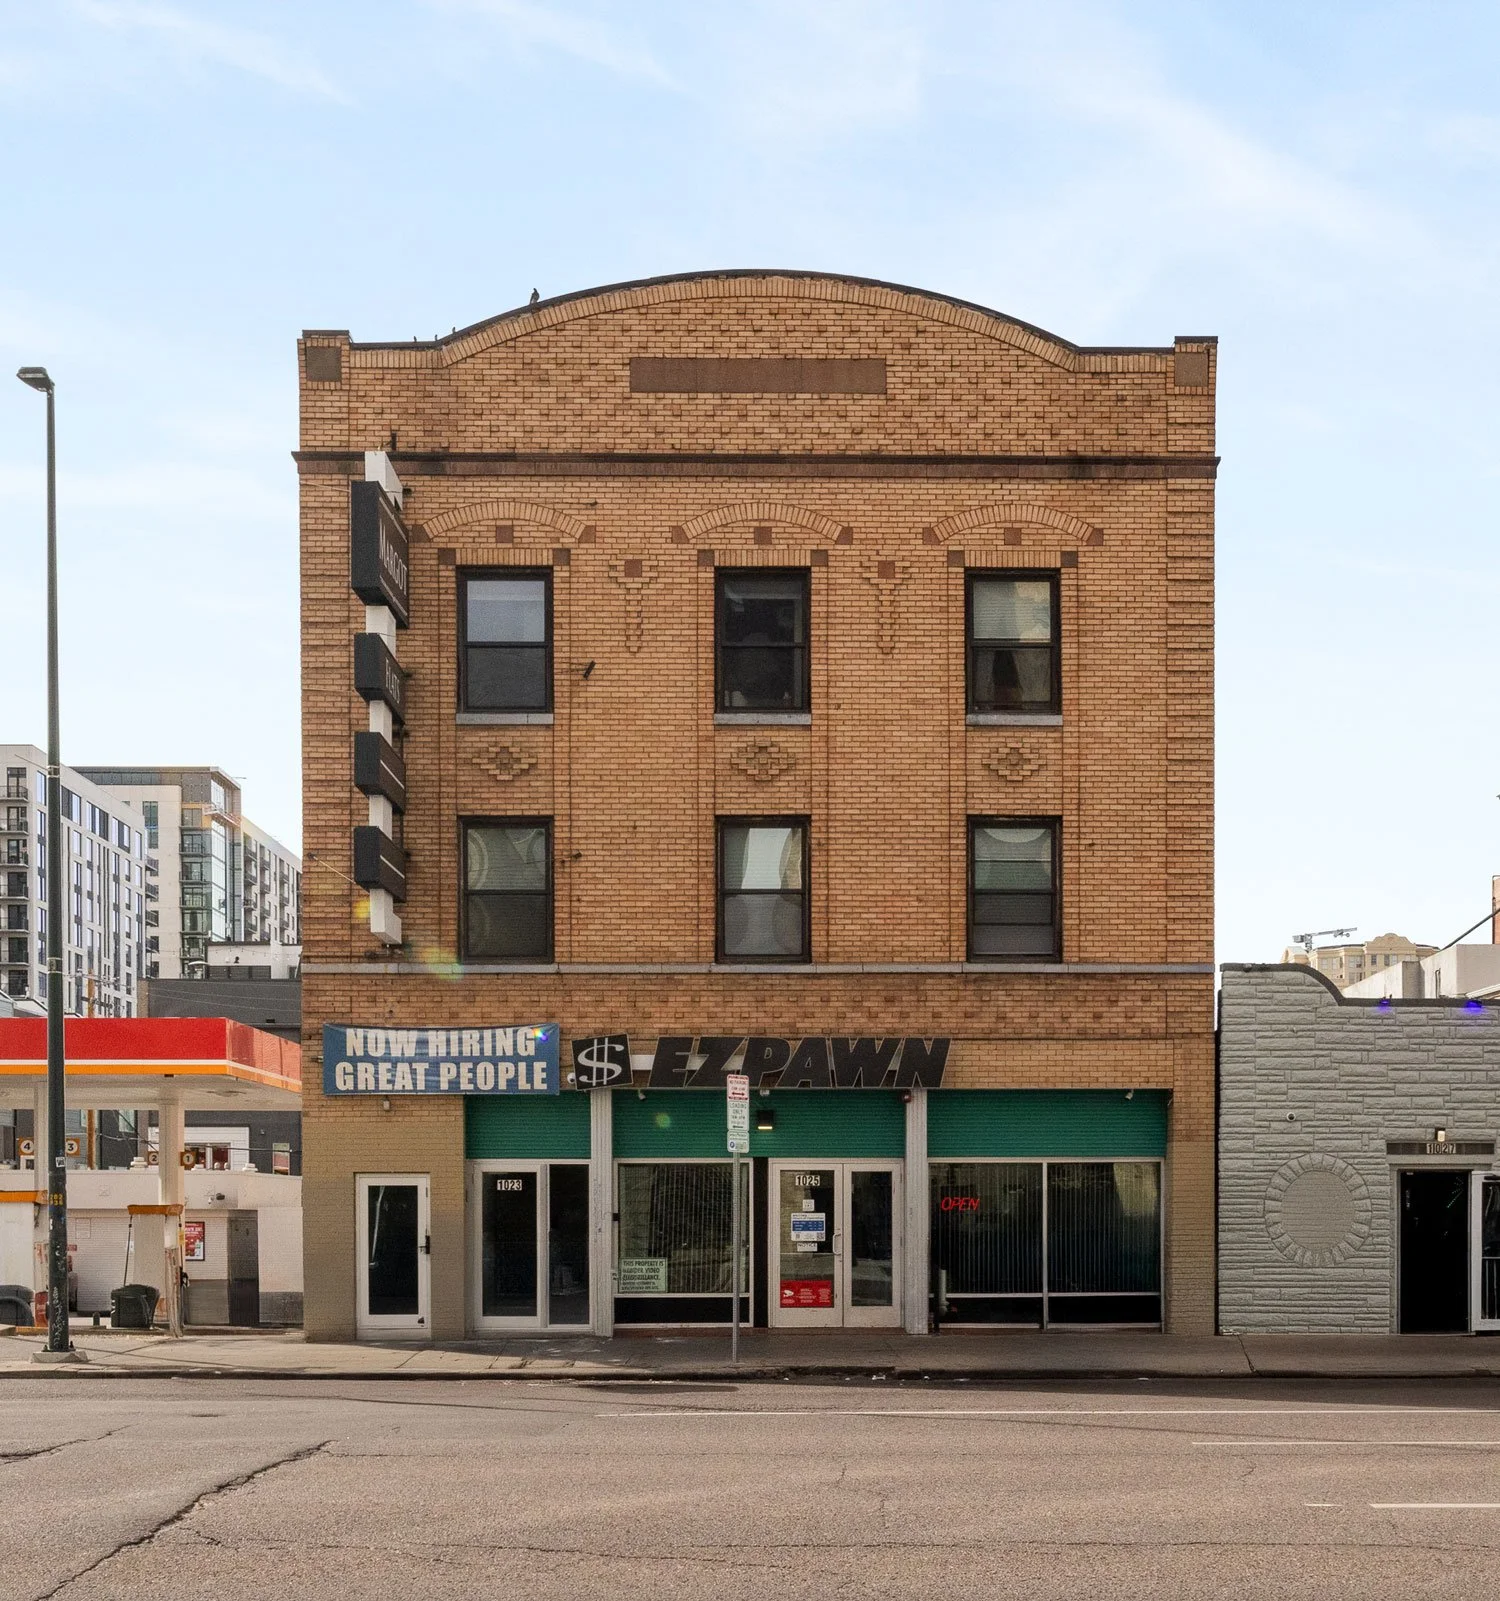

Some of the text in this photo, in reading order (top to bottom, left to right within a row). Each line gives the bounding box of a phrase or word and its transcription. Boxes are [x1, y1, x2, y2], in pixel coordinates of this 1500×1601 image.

[379, 519, 408, 596] MARGOT
[385, 657, 400, 704] FLATS
[346, 1027, 536, 1057] NOW HIRING
[577, 1036, 625, 1086] $
[335, 1061, 548, 1091] GREAT PEOPLE
[23, 1142, 31, 1151] 4
[67, 1143, 75, 1151] 3
[1428, 1143, 1455, 1154] 1027
[151, 1154, 158, 1162] 2
[498, 1180, 521, 1190] 1023
[796, 1175, 819, 1186] 1025
[941, 1196, 979, 1211] OPEN
